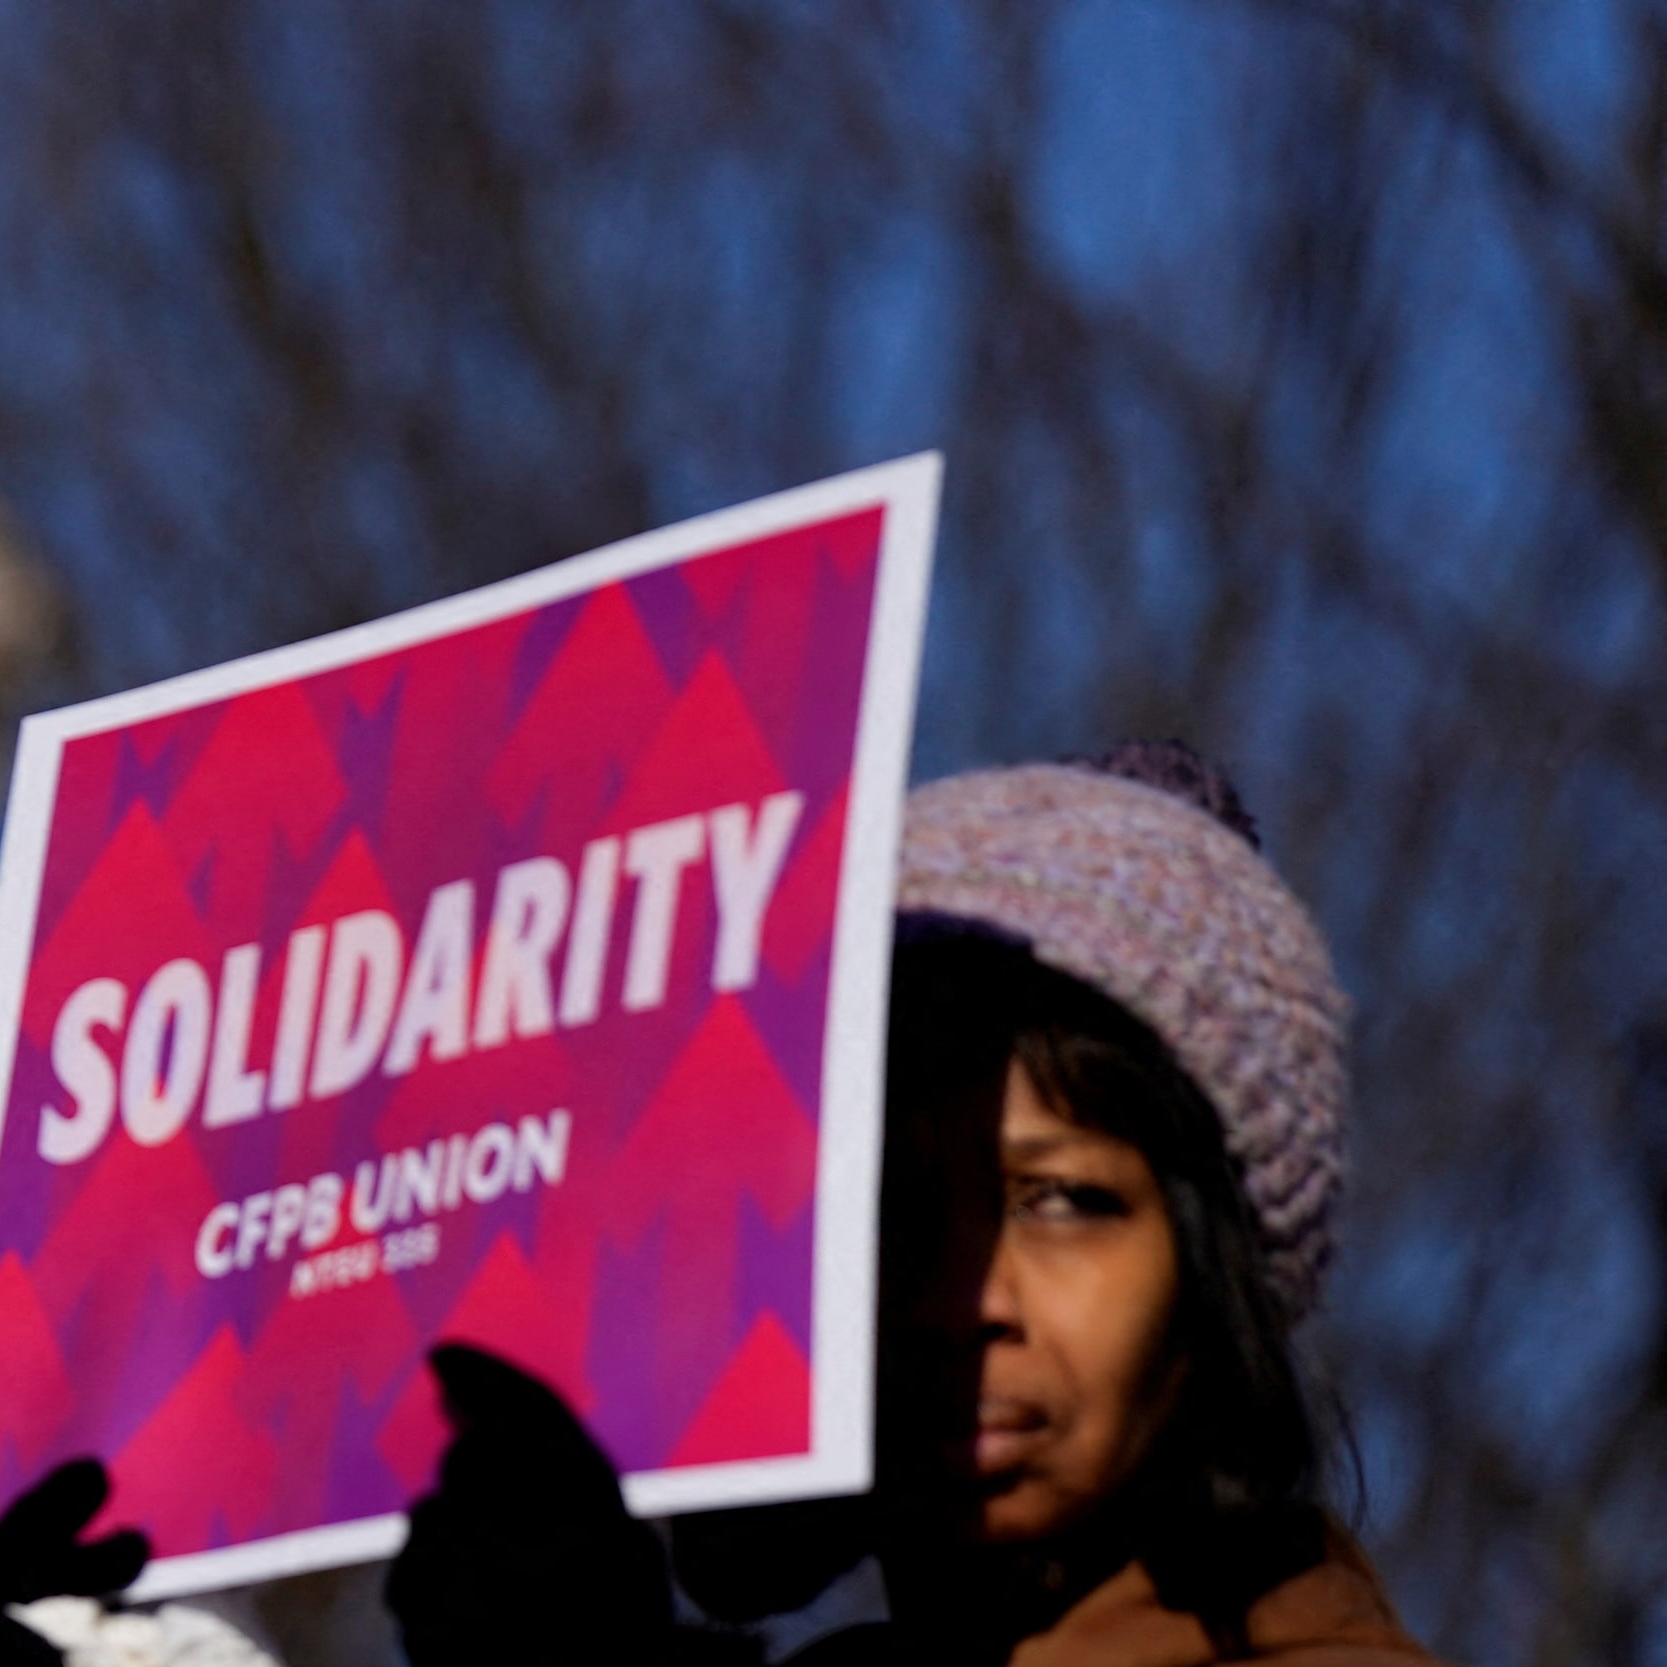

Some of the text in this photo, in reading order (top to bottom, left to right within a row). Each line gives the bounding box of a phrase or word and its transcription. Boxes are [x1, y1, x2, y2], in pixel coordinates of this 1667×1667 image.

[37, 788, 805, 1166] SOLIDARITY
[194, 1106, 573, 1280] CFPB UNION
